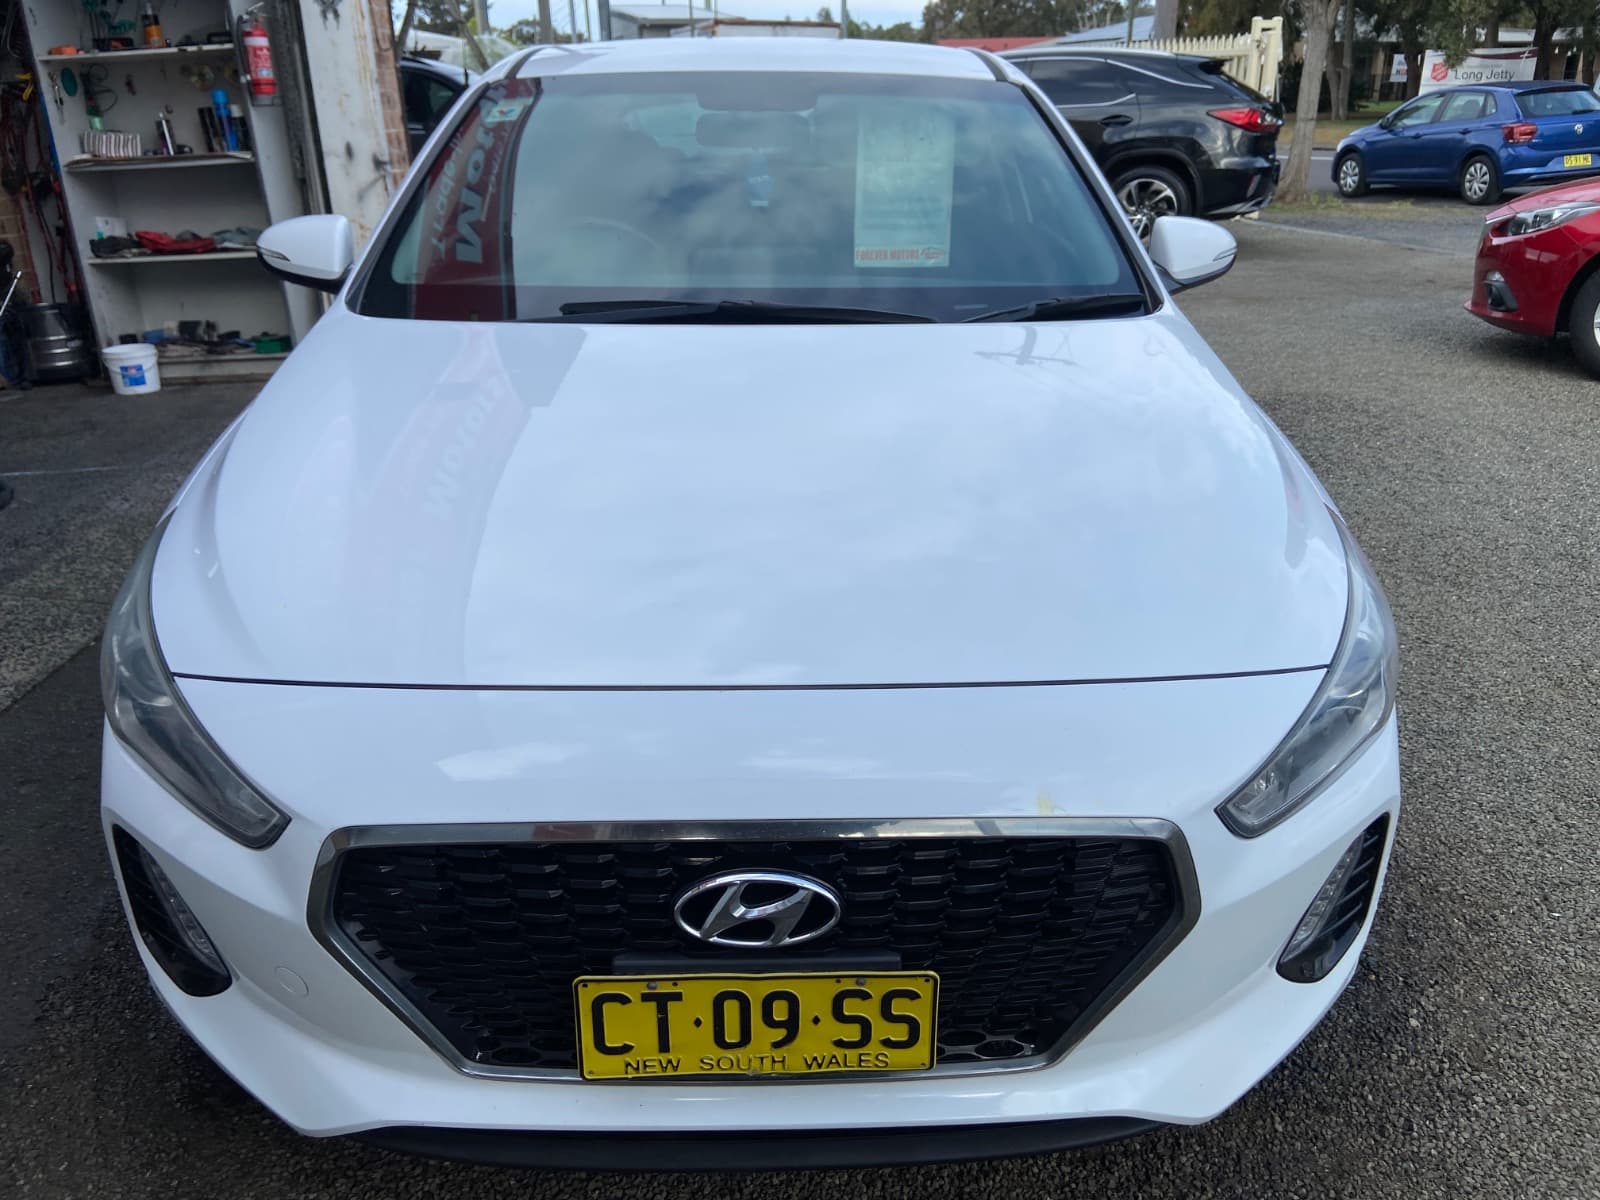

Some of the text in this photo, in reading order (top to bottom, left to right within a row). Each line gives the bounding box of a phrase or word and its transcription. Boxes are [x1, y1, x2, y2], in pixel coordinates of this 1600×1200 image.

[1454, 69, 1483, 81] Long
[1486, 69, 1516, 81] Jetty
[624, 1052, 890, 1075] NEW SOUTH WALES
